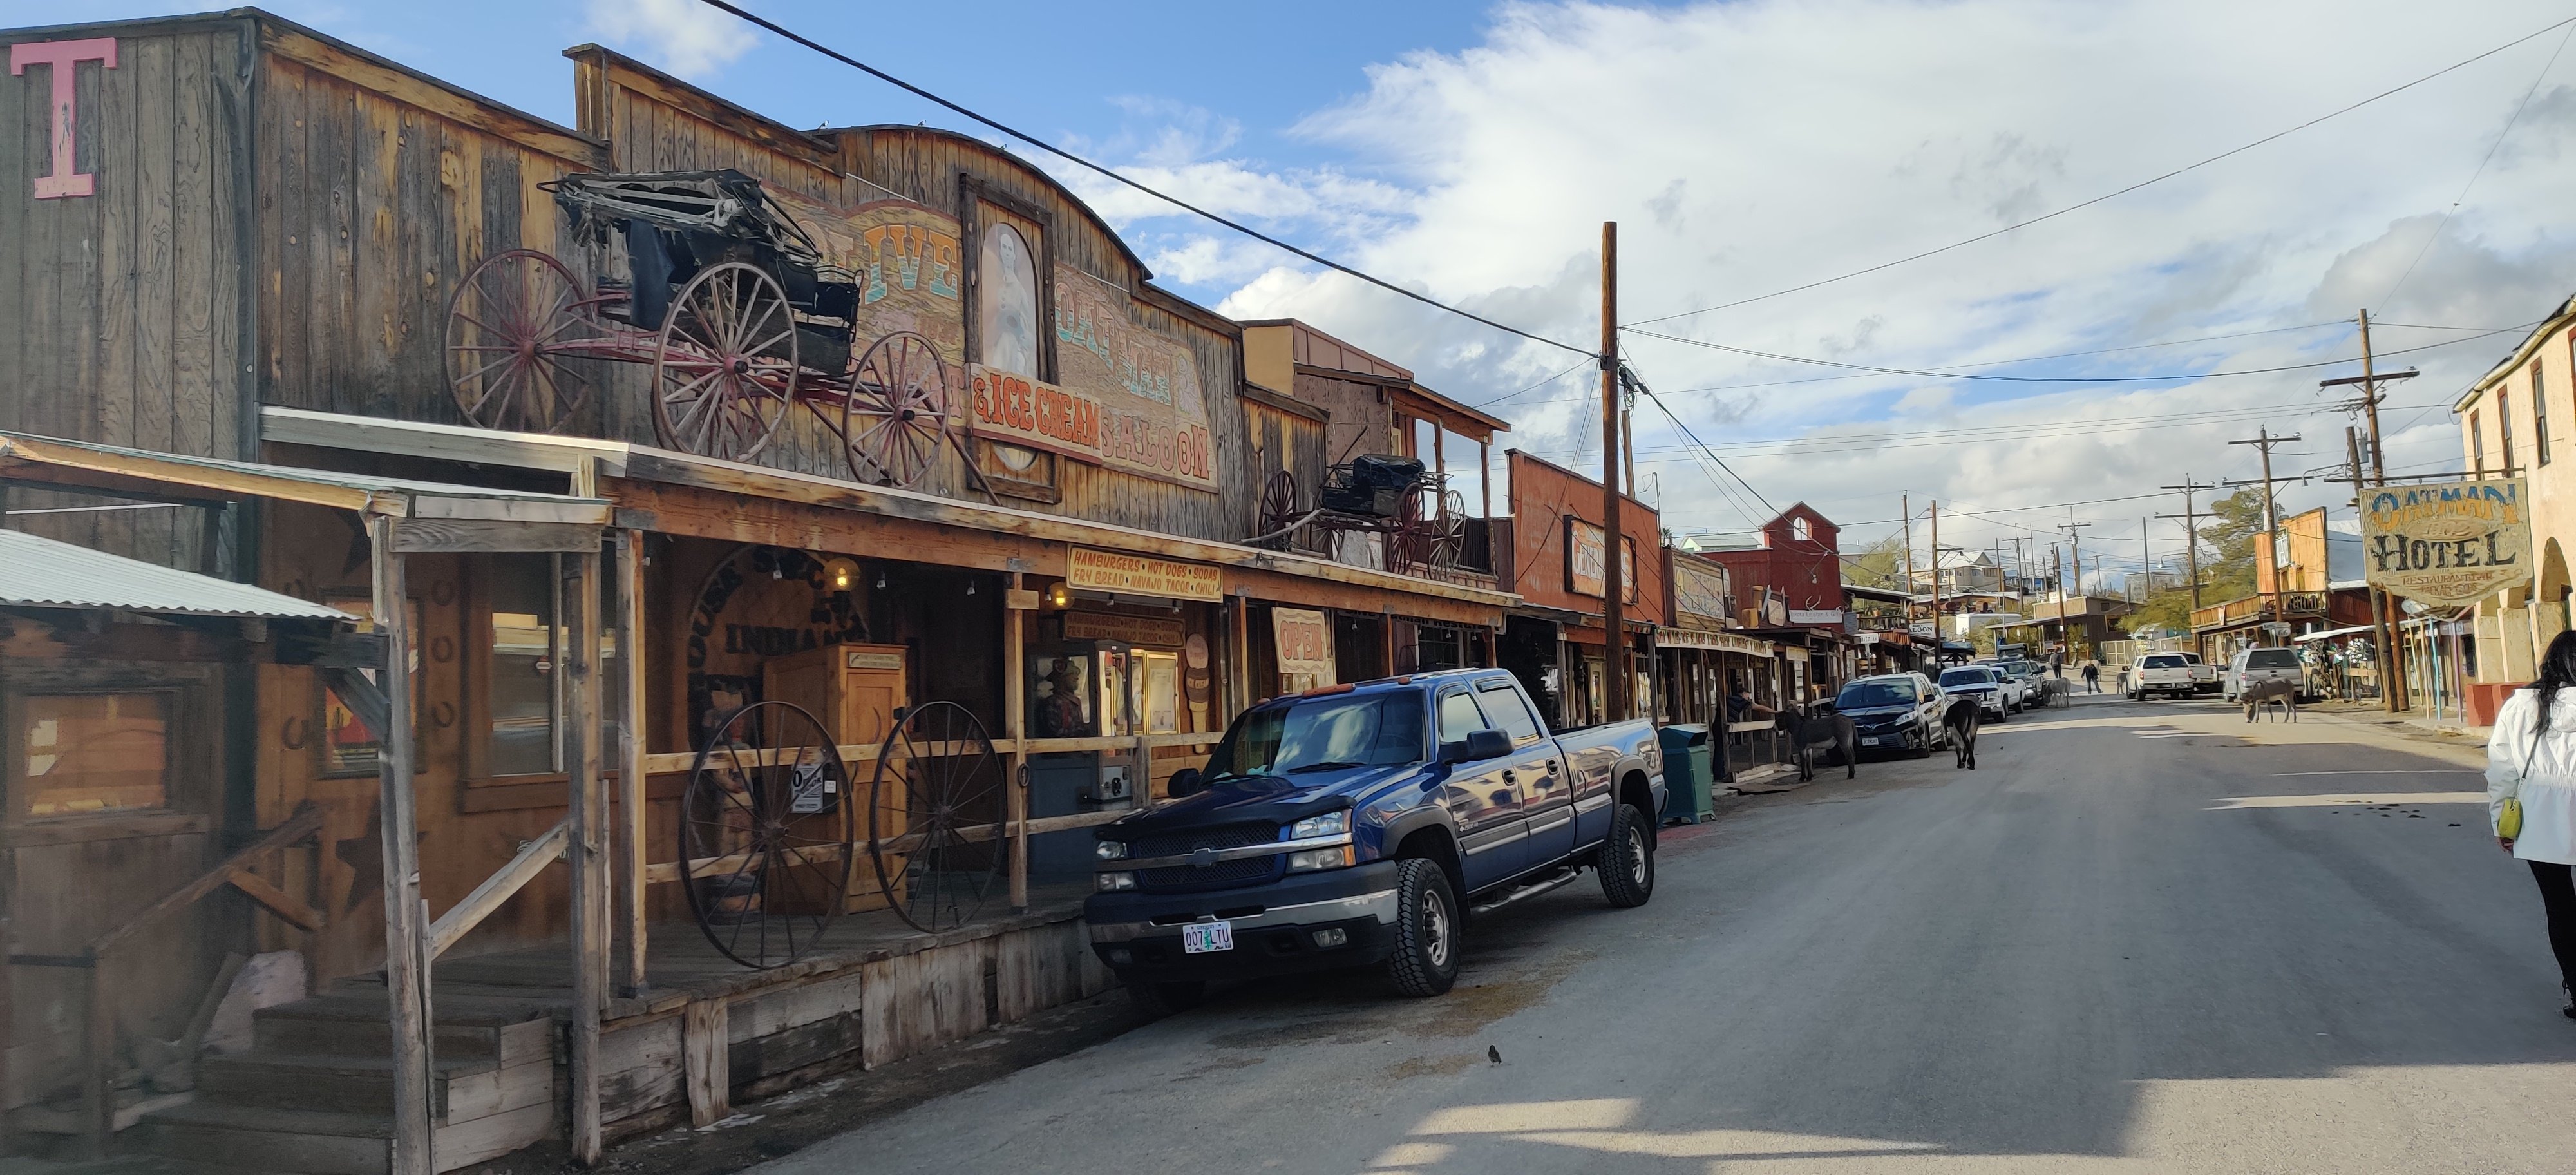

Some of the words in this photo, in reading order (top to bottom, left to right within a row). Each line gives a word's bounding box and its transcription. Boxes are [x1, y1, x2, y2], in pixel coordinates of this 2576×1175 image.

[10, 37, 118, 200] T
[990, 372, 1035, 432] ICE
[1035, 387, 1101, 451] CREAM
[1100, 415, 1210, 481] SALOON
[2371, 483, 2519, 531] OATMAN
[1074, 550, 1141, 573] HAMBURGERS
[1148, 561, 1164, 575] HOT
[1166, 562, 1187, 578] DOGS
[1193, 566, 1217, 581] SODAS
[2371, 529, 2517, 572] HOTEL
[1073, 568, 1092, 583] FRY
[1095, 571, 1124, 587] BREAD
[1130, 574, 1162, 591] NAVAJO
[1166, 578, 1190, 594] TACOS
[1195, 581, 1215, 596] CHILI
[1280, 620, 1324, 662] OPEN
[1186, 930, 1203, 946] 007
[1209, 928, 1229, 944] LTU
